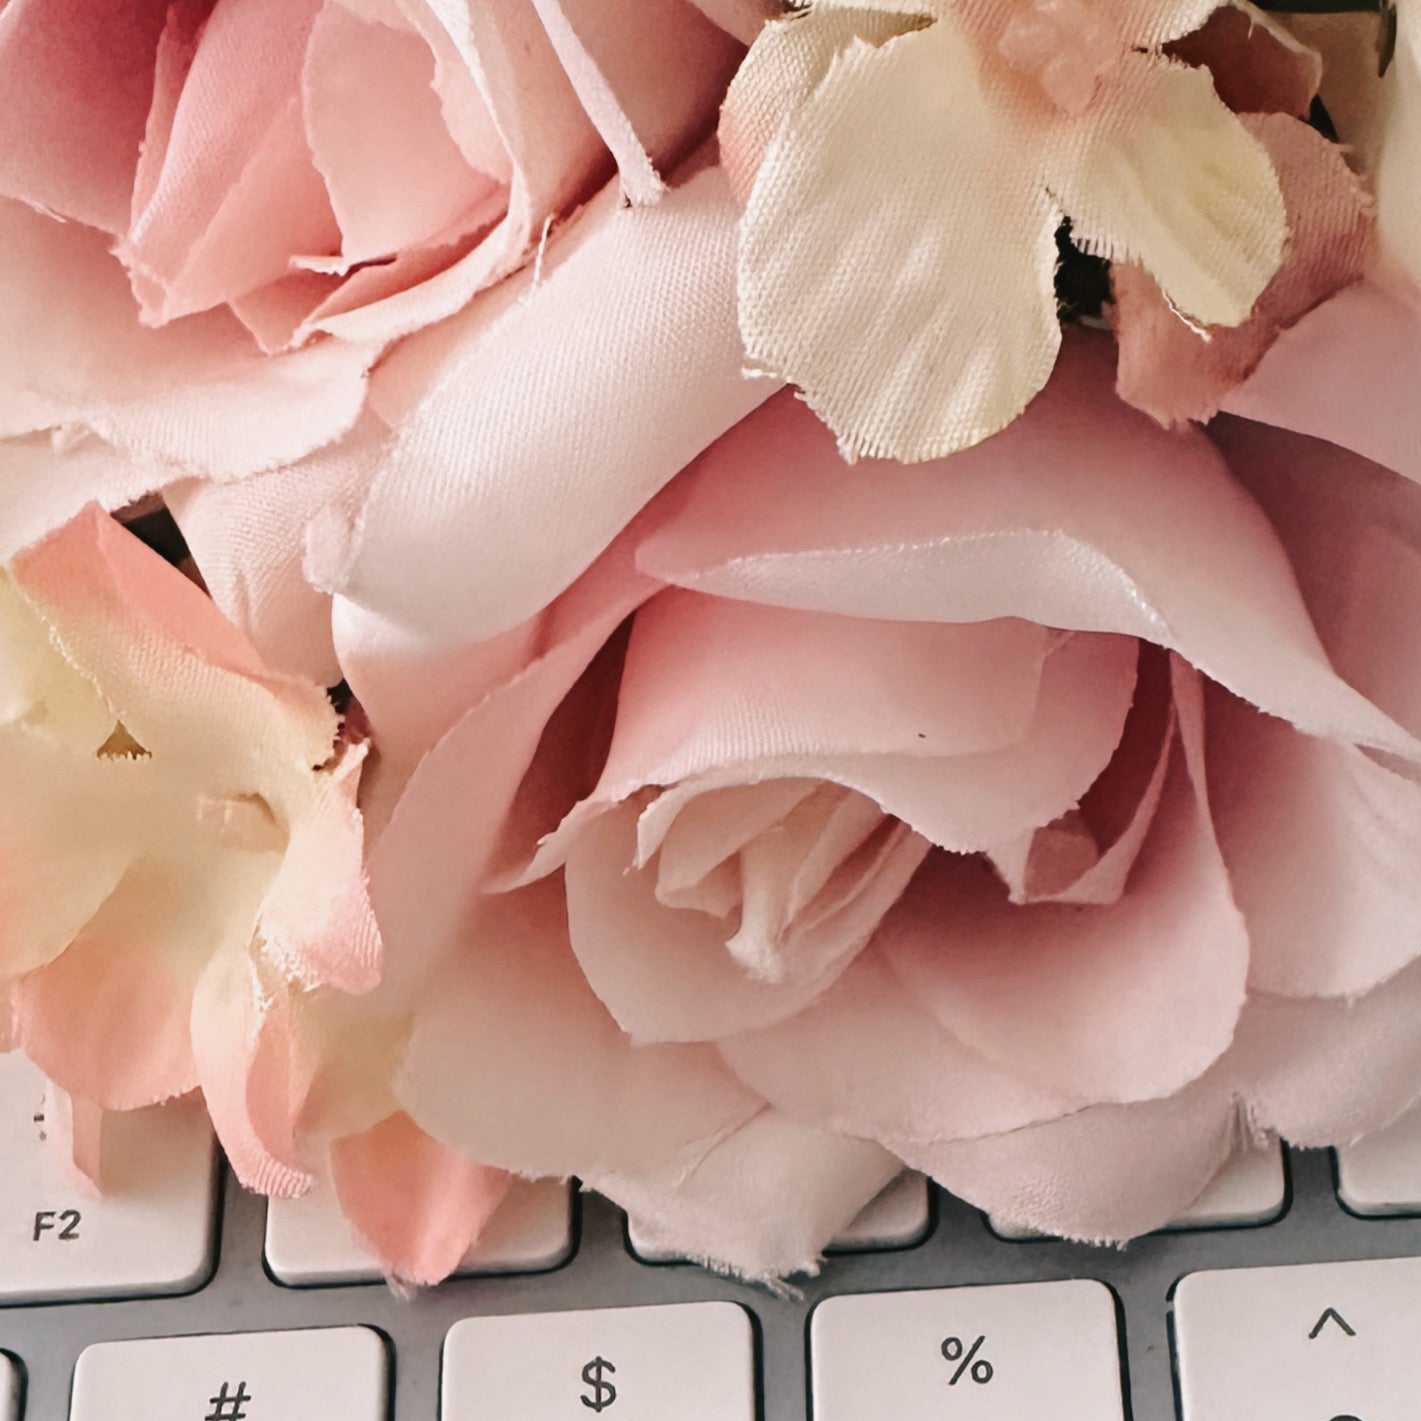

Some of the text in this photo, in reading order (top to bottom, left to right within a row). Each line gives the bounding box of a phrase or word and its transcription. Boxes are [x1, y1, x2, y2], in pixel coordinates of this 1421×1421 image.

[32, 1209, 82, 1242] F2
[579, 1355, 617, 1414] $
[940, 1334, 994, 1387] %
